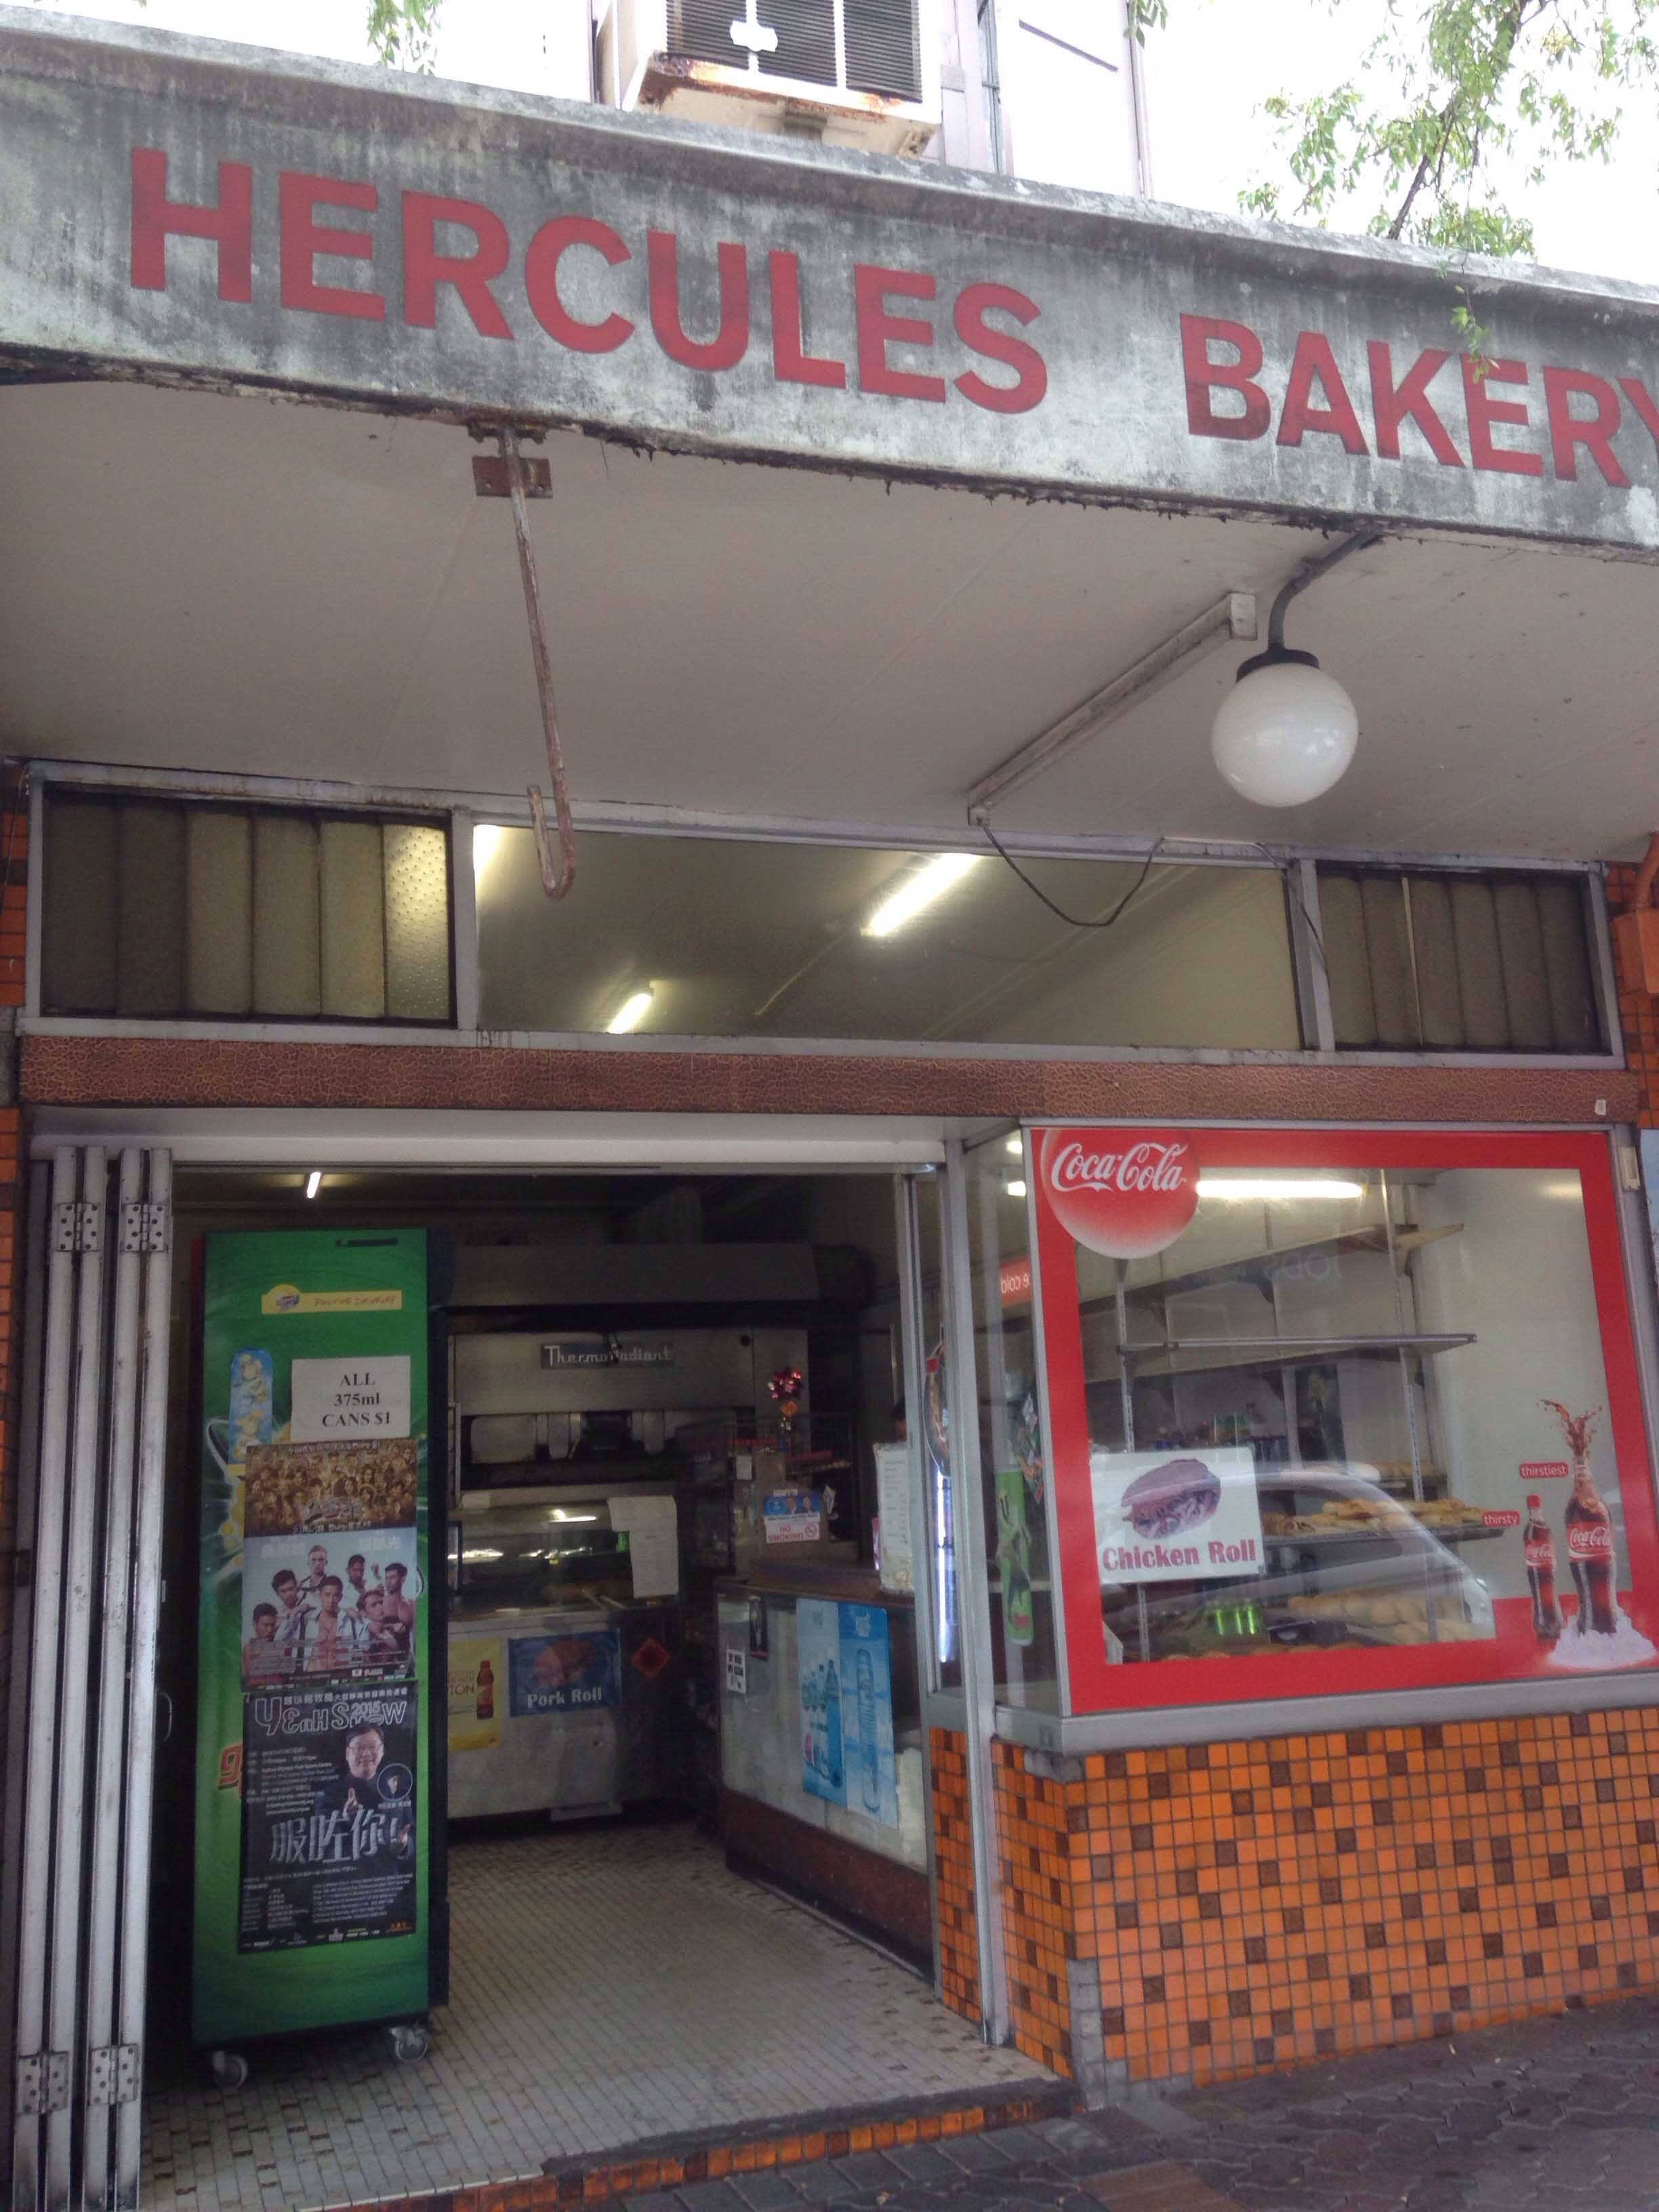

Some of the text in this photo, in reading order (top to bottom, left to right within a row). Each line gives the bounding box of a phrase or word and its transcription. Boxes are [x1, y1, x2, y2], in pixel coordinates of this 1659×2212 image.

[131, 146, 1048, 414] HERCULES
[1052, 1142, 1188, 1192] Coca-Cola
[339, 1372, 376, 1387] ALL
[334, 1392, 380, 1406] 375ml
[322, 1411, 390, 1427] CANS $1
[1521, 1464, 1567, 1477] thirstiest
[1483, 1512, 1519, 1525] thirsty
[1103, 1538, 1256, 1571] Chicken Roll
[527, 1686, 602, 1708] Pork Roll
